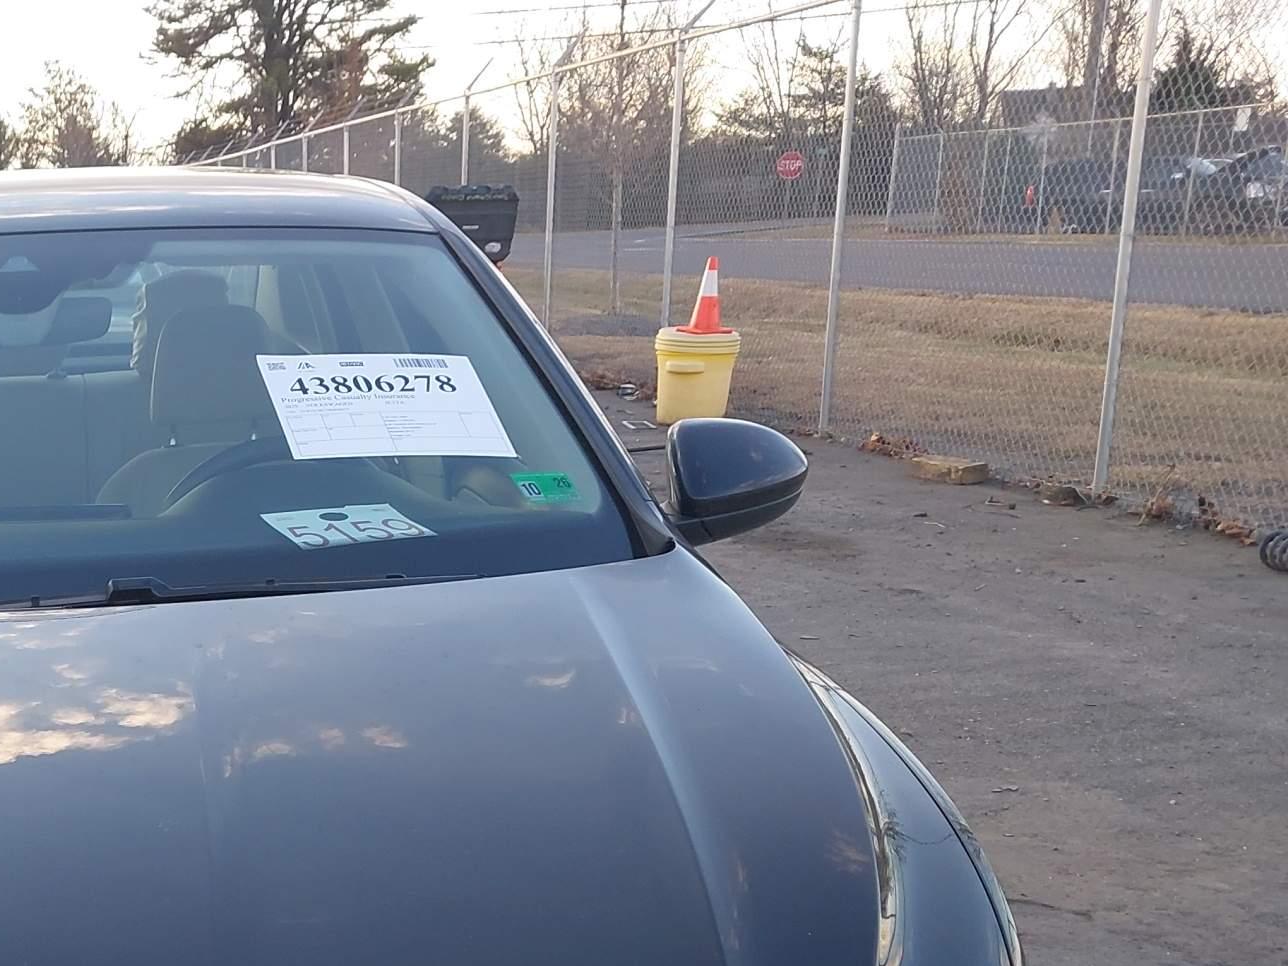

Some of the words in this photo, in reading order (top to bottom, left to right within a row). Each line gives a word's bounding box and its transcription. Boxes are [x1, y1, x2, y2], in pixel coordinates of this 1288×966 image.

[778, 160, 802, 170] STOP
[290, 374, 457, 395] 43806278
[334, 393, 372, 401] Casualty
[374, 392, 416, 400] Insurance
[520, 482, 541, 496] 10
[287, 518, 425, 547] 5159
